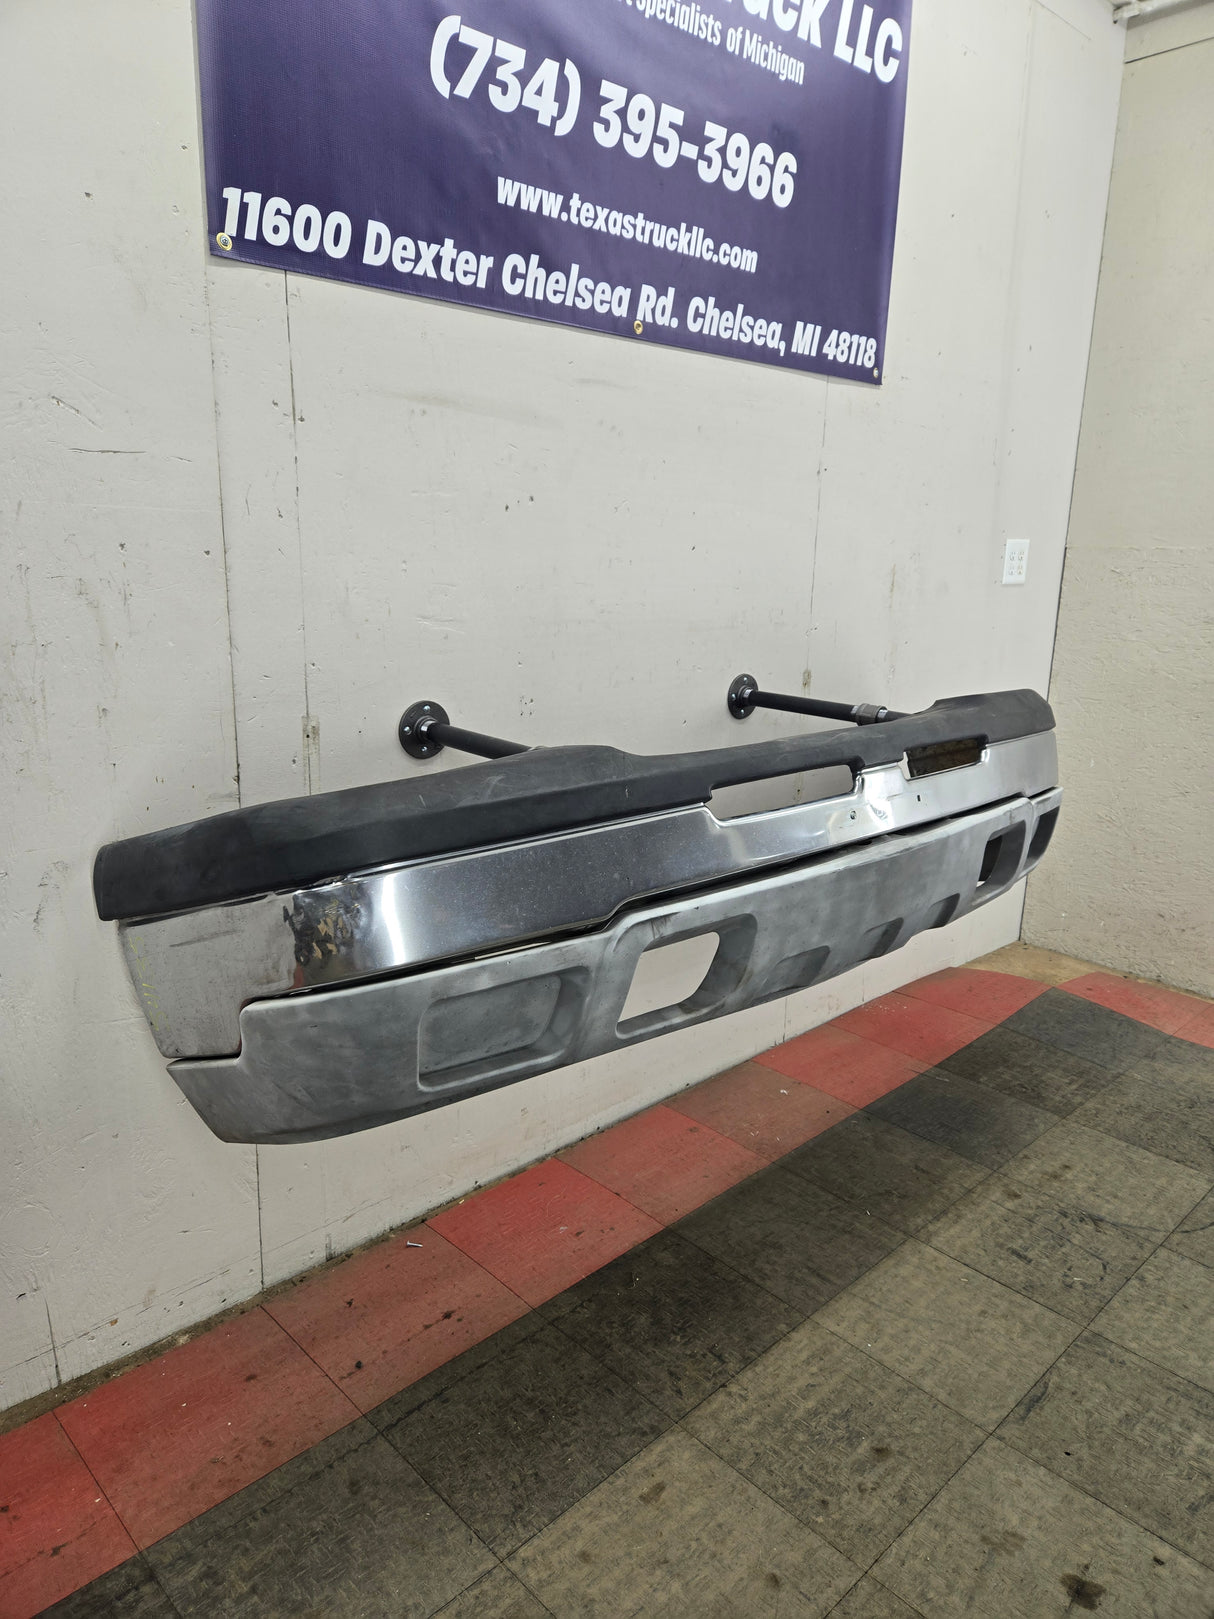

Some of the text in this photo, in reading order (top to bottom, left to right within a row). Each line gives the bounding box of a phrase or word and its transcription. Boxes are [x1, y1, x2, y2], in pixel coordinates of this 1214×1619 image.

[726, 26, 744, 56] of
[742, 29, 805, 86] Michigan
[833, 0, 904, 83] LLC
[430, 14, 798, 208] (734) 395-3966
[497, 176, 758, 273] www.texastruckllc.com
[222, 186, 877, 368] 11600 Dexter Chelsea Rd. Chelsea, MI 48118
